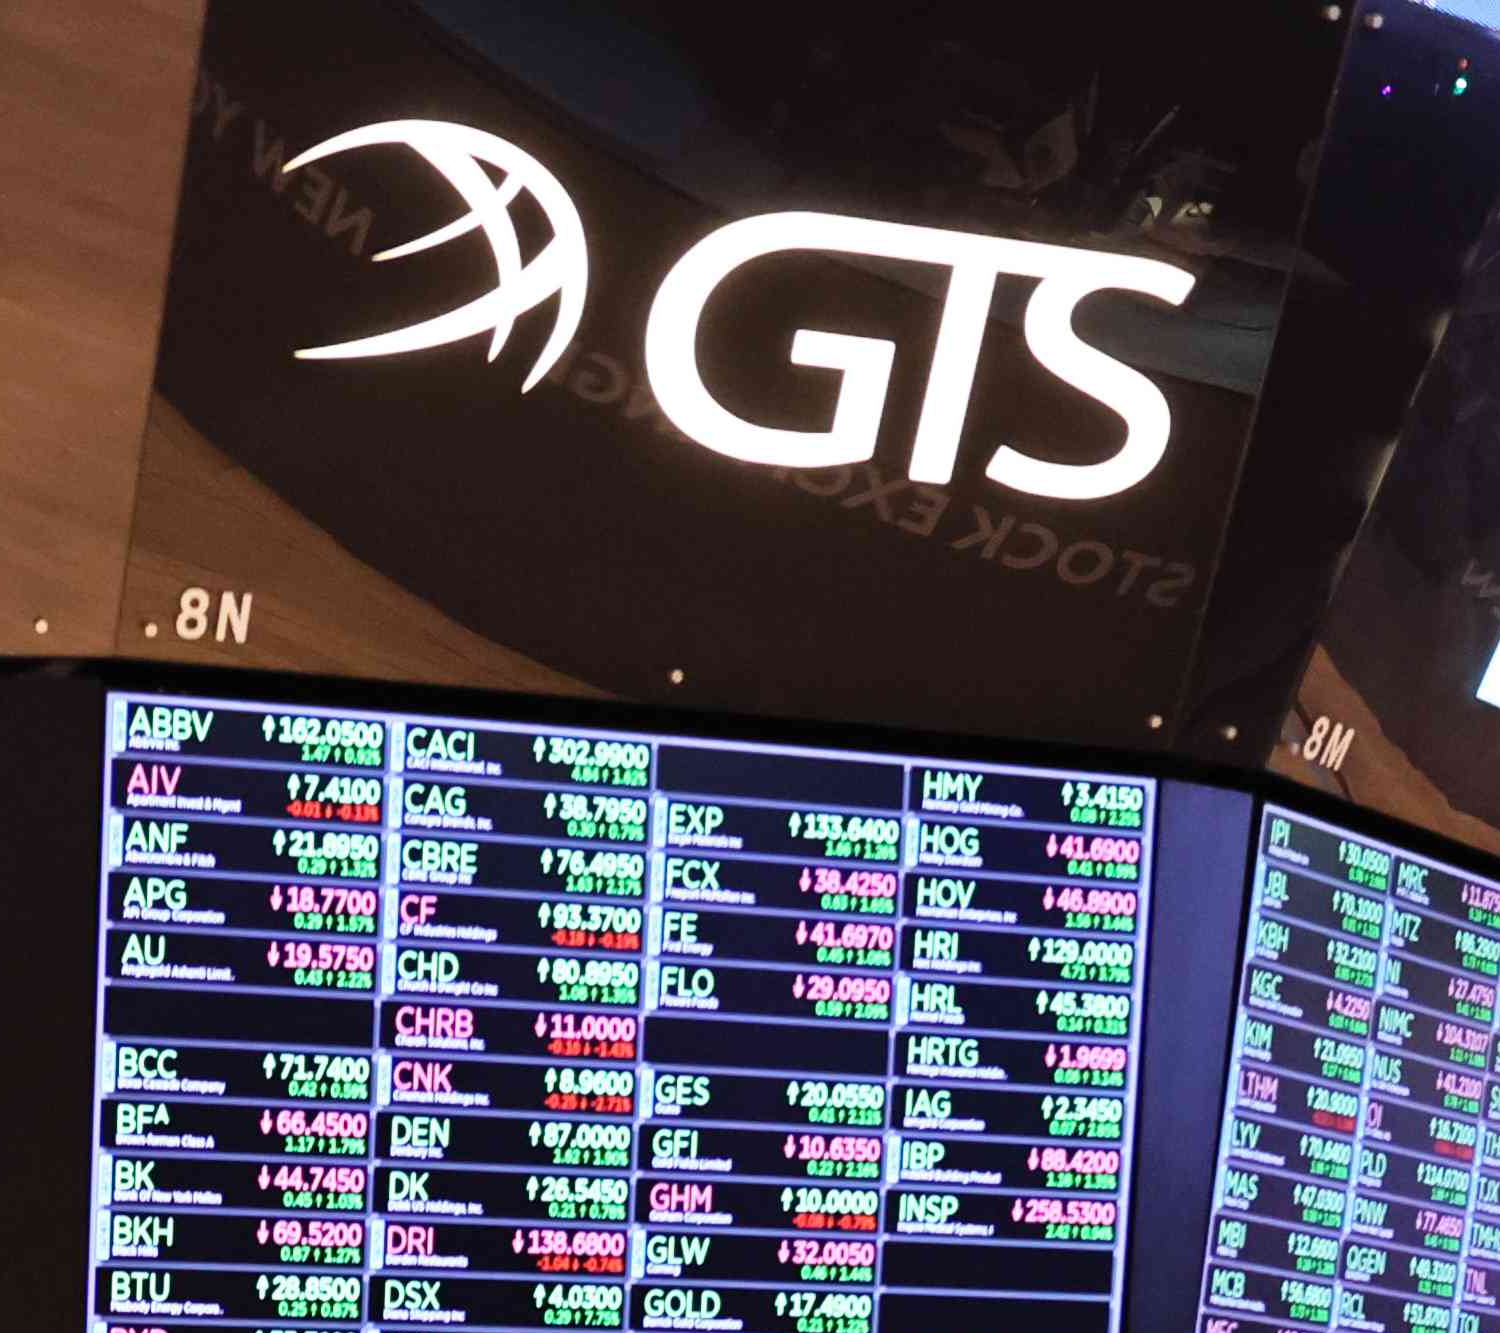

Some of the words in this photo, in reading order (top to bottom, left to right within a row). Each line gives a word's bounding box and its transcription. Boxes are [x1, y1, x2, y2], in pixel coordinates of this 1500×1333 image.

[645, 209, 1197, 503] GTS
[175, 588, 253, 647] 8N
[129, 707, 213, 743] ABBV
[407, 727, 475, 762] CACI
[1302, 715, 1354, 772] 8M
[923, 770, 983, 804] HMY
[401, 840, 478, 873] CBRE
[666, 857, 720, 890] FCX
[907, 1037, 980, 1067] HRTG
[898, 1194, 959, 1226] INSP
[110, 1271, 171, 1302] BTU
[643, 1289, 722, 1320] GOLD
